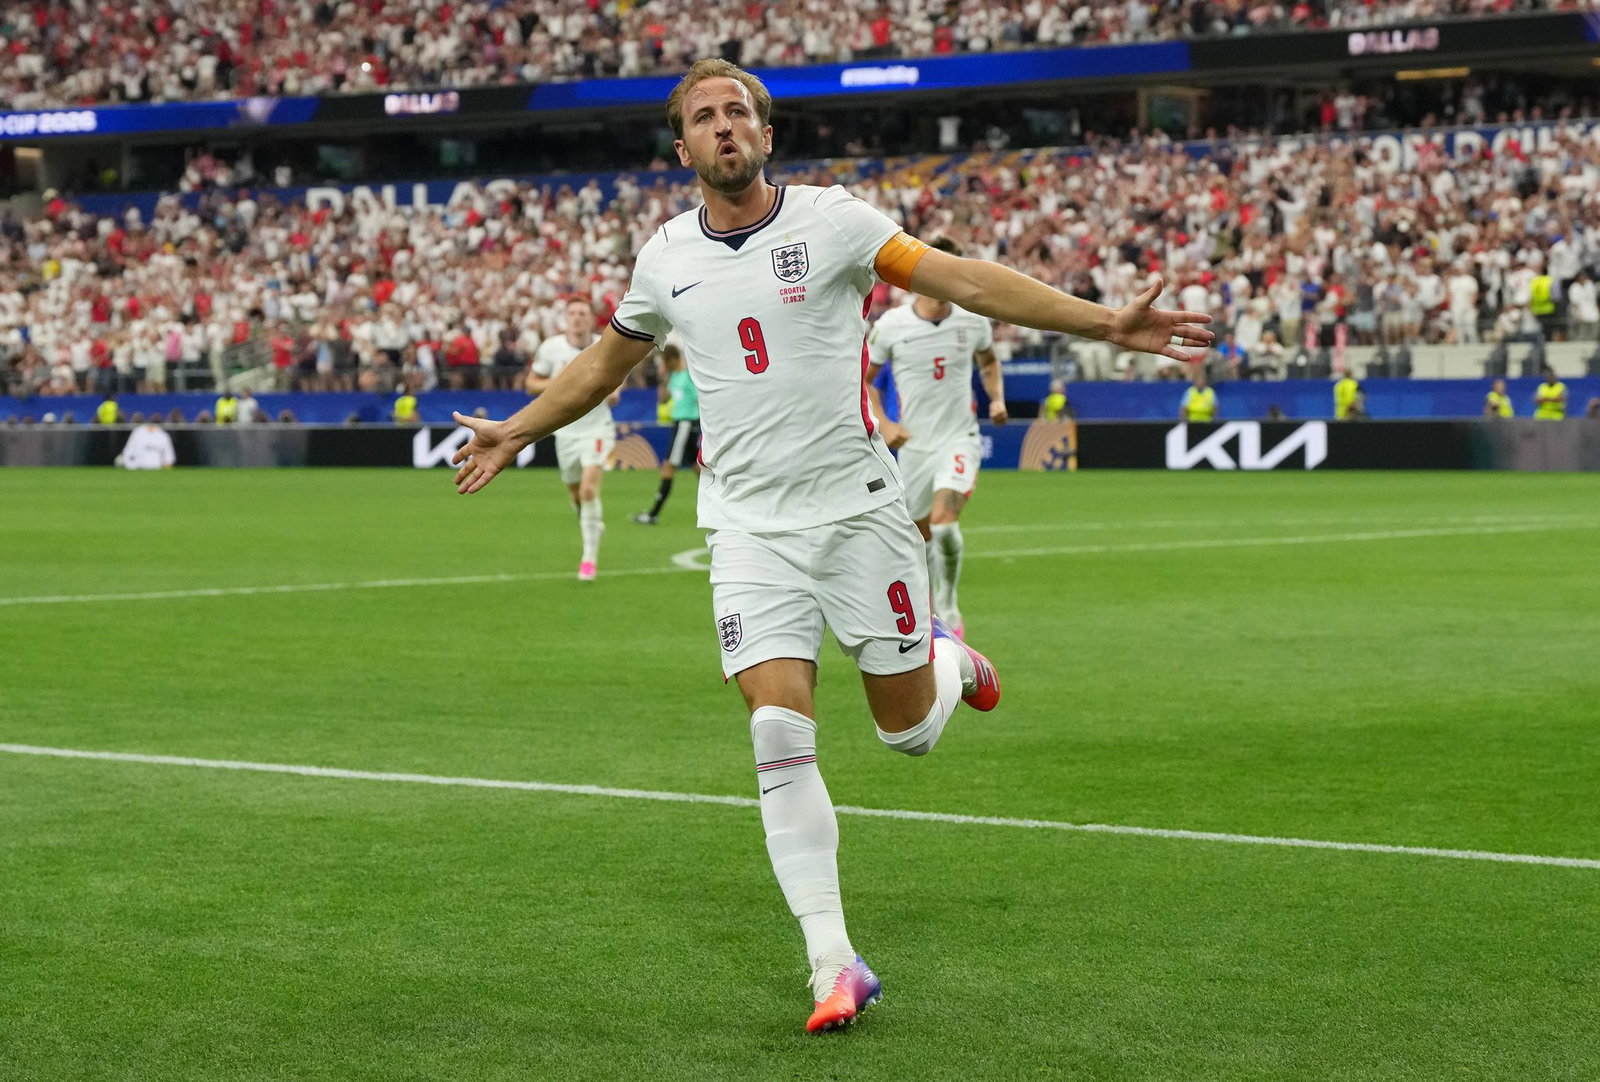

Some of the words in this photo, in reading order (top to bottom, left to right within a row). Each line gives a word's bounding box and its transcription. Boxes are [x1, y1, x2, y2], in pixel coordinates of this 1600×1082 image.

[779, 285, 807, 296] CROATIA
[782, 294, 806, 304] 17.06.26
[737, 316, 769, 375] 9
[933, 357, 945, 380] 5
[1165, 420, 1328, 471] KIA
[953, 454, 965, 474] 5
[887, 580, 917, 636] 9
